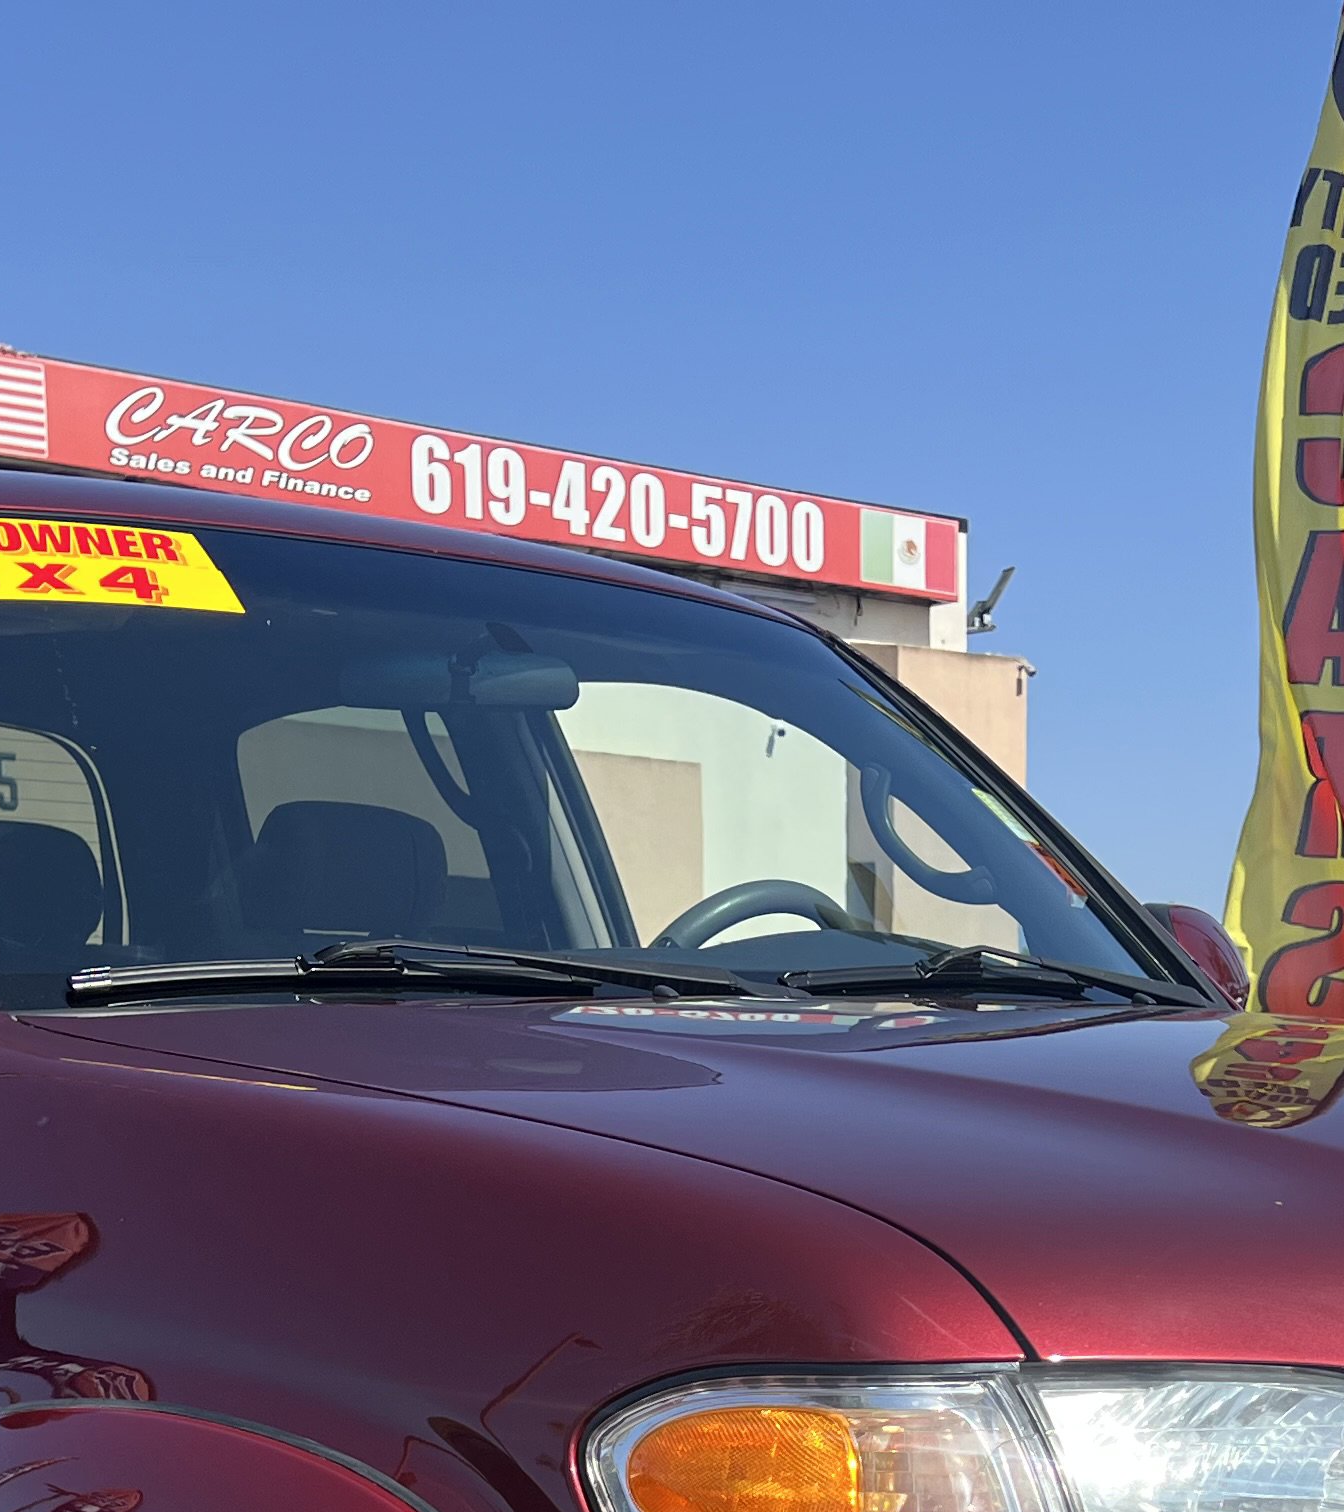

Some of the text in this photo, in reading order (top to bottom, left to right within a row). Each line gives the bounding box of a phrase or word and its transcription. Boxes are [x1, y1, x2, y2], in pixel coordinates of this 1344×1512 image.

[104, 386, 374, 472] CARCO
[109, 447, 372, 502] Sales and Finance
[411, 433, 825, 573] 619-420-5700
